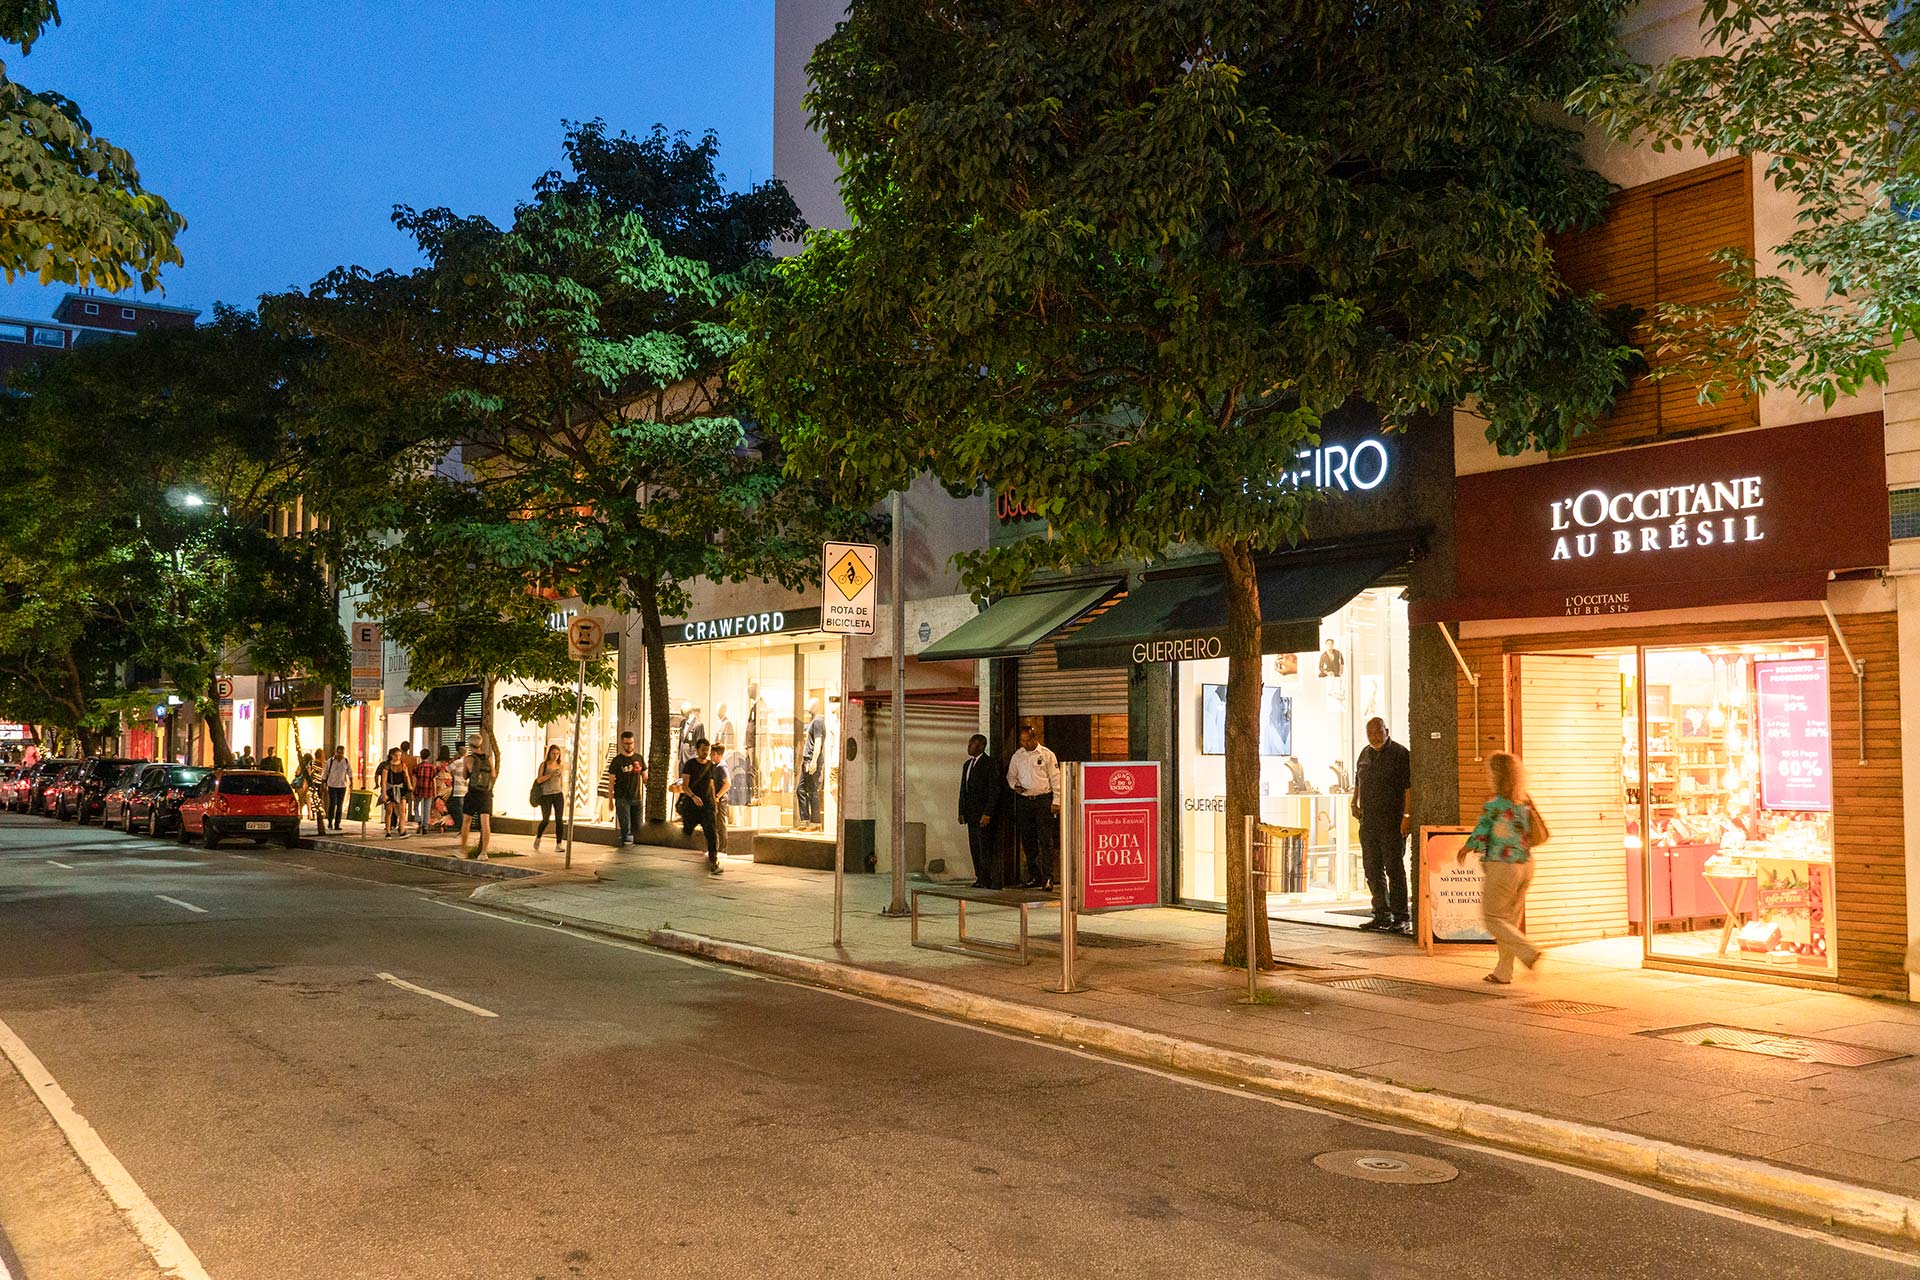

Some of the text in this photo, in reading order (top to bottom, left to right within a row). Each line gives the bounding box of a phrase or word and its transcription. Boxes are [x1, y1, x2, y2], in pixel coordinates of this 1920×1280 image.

[1550, 476, 1764, 531] L'OCCITANE
[1551, 515, 1764, 560] AU BRÉSIL
[1565, 593, 1630, 607] L'OCCITANE
[830, 605, 868, 615] ROTA DE
[1565, 607, 1580, 616] AU
[684, 611, 784, 641] CRAWFORD
[826, 618, 871, 628] BICICLETA
[362, 628, 371, 642] E
[1132, 636, 1222, 663] GUERREIRO
[219, 683, 227, 695] E
[1778, 760, 1823, 777] 60%
[1184, 798, 1226, 813] GUERREI
[1098, 833, 1140, 849] BOTA
[1095, 848, 1144, 867] FORA
